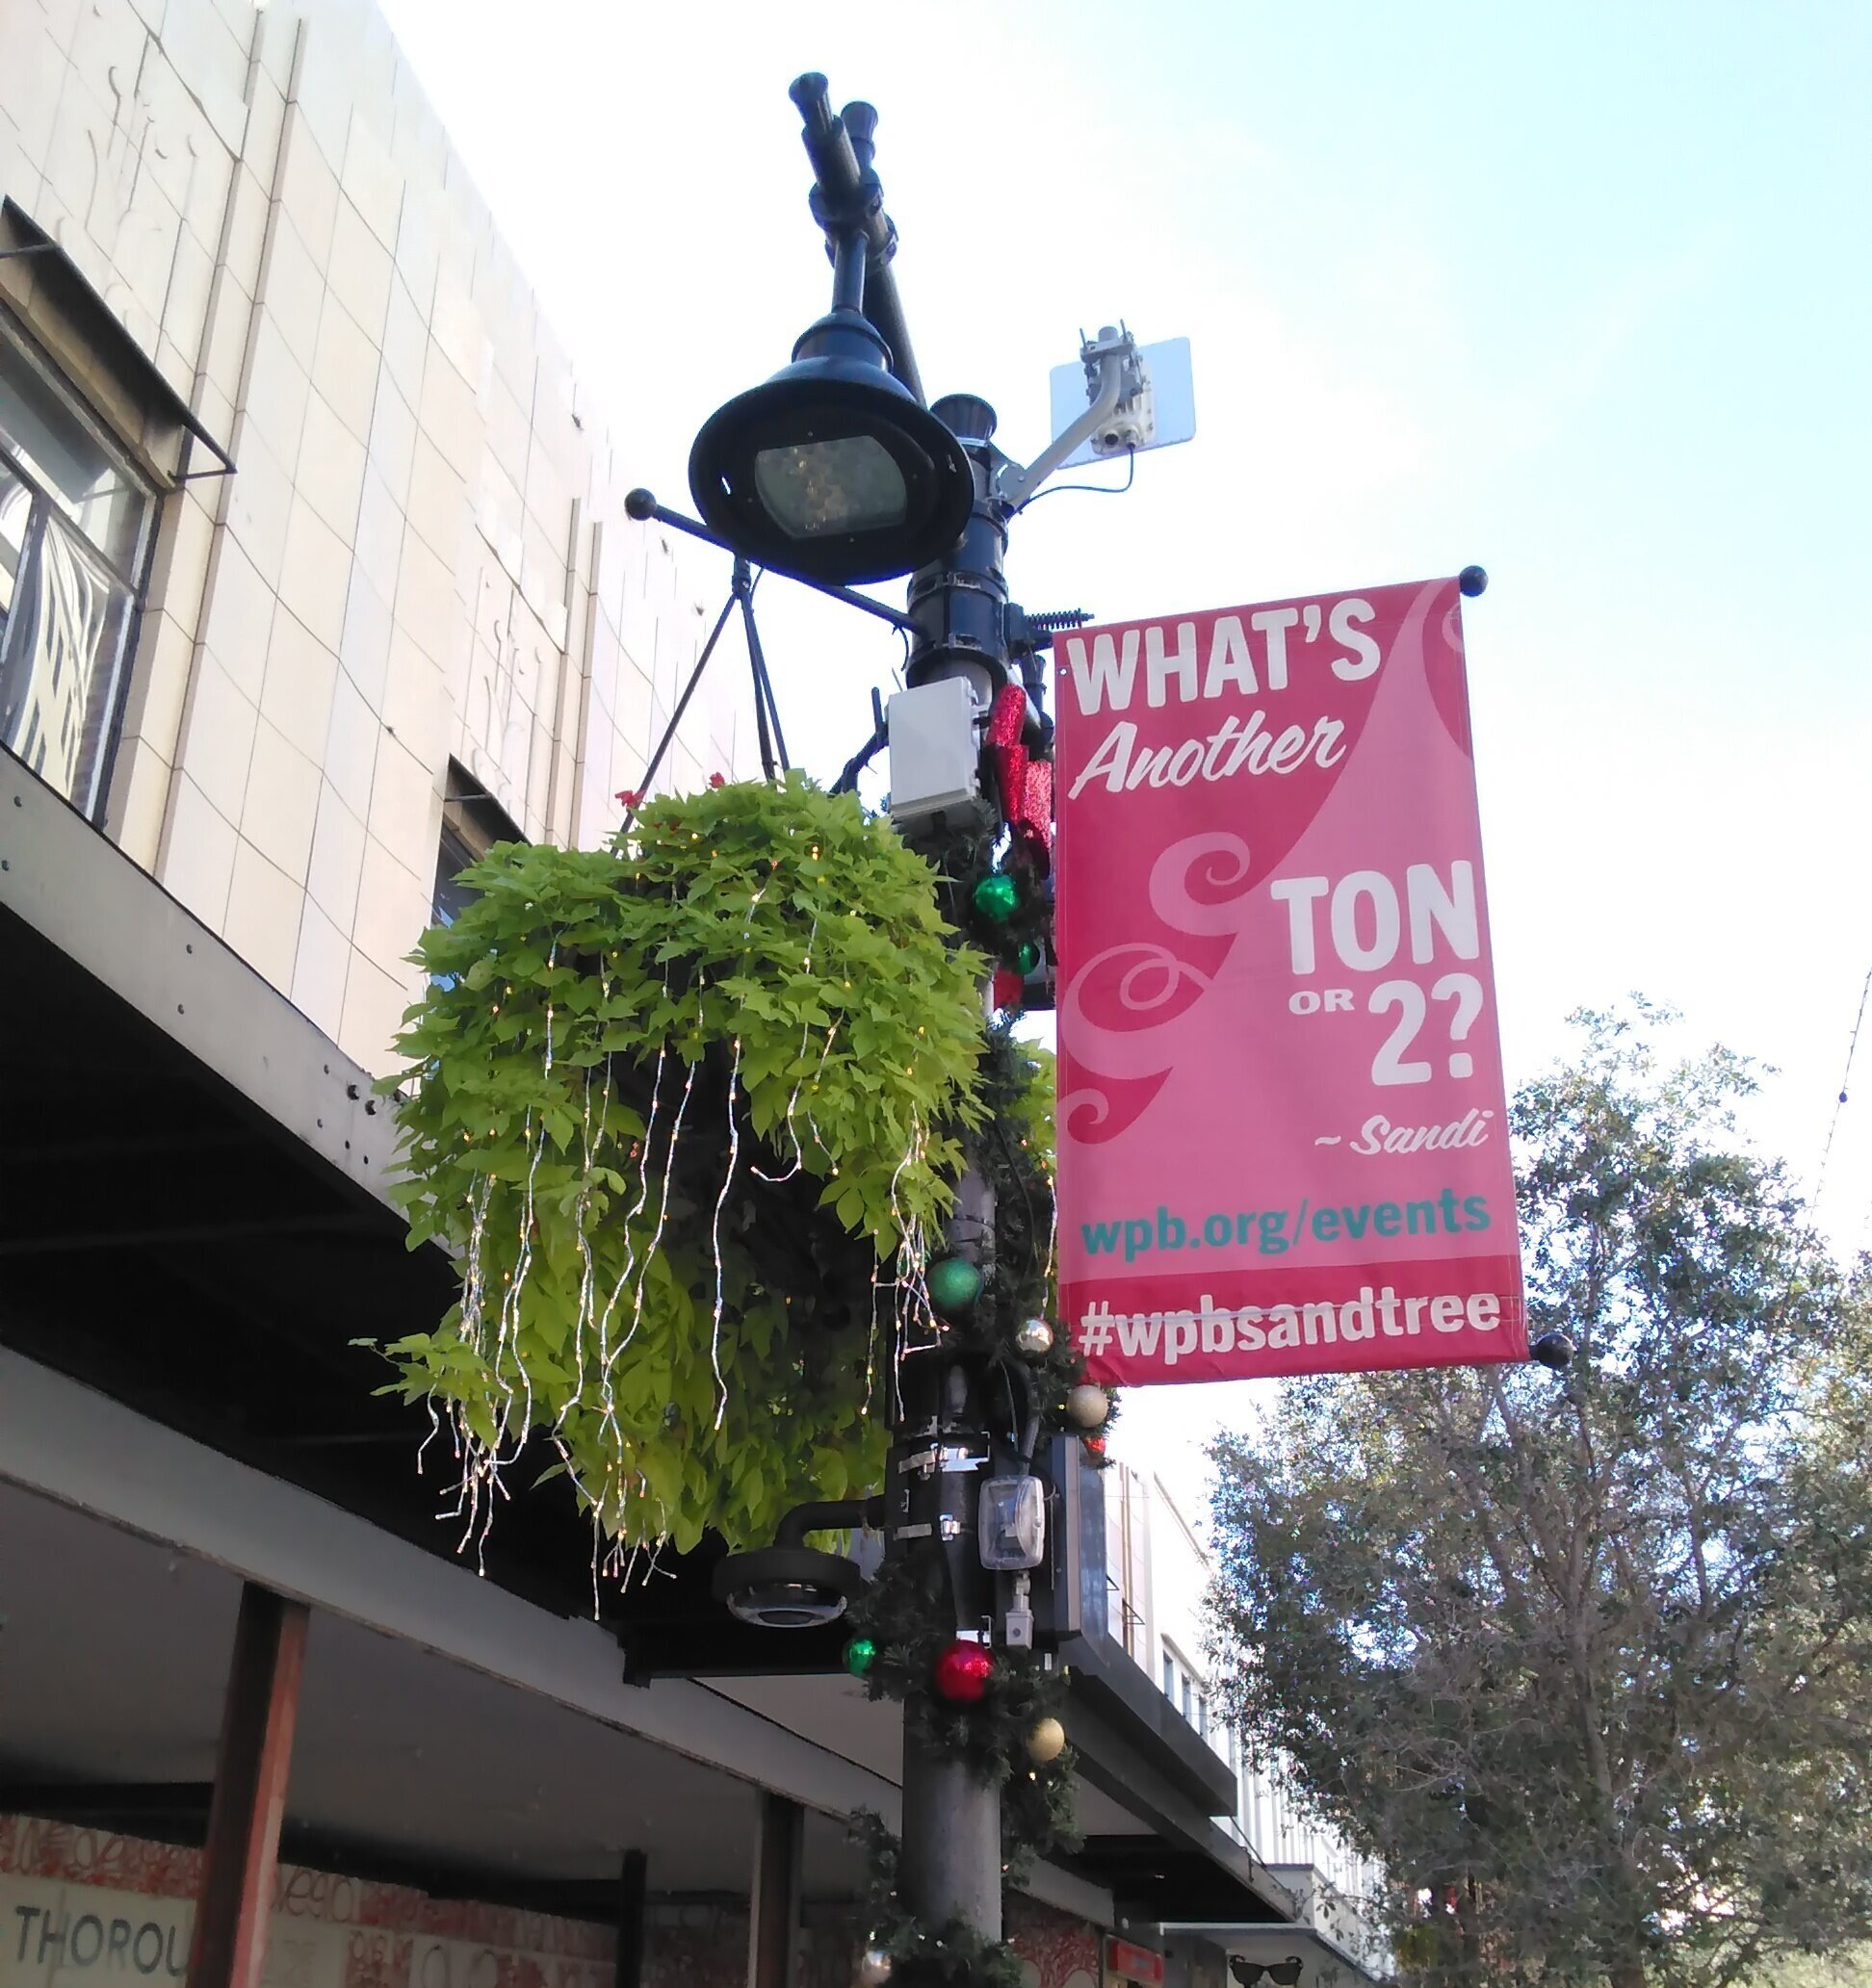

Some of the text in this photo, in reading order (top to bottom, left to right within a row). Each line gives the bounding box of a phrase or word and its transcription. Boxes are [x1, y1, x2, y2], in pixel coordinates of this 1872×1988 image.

[1067, 598, 1381, 715] WHAT'S
[1068, 710, 1345, 800] Another
[1271, 860, 1480, 975] TON
[1288, 973, 1484, 1086] OR 2?
[1081, 1188, 1492, 1262] wpb.org/events
[1078, 1286, 1501, 1365] #wpbsandtree
